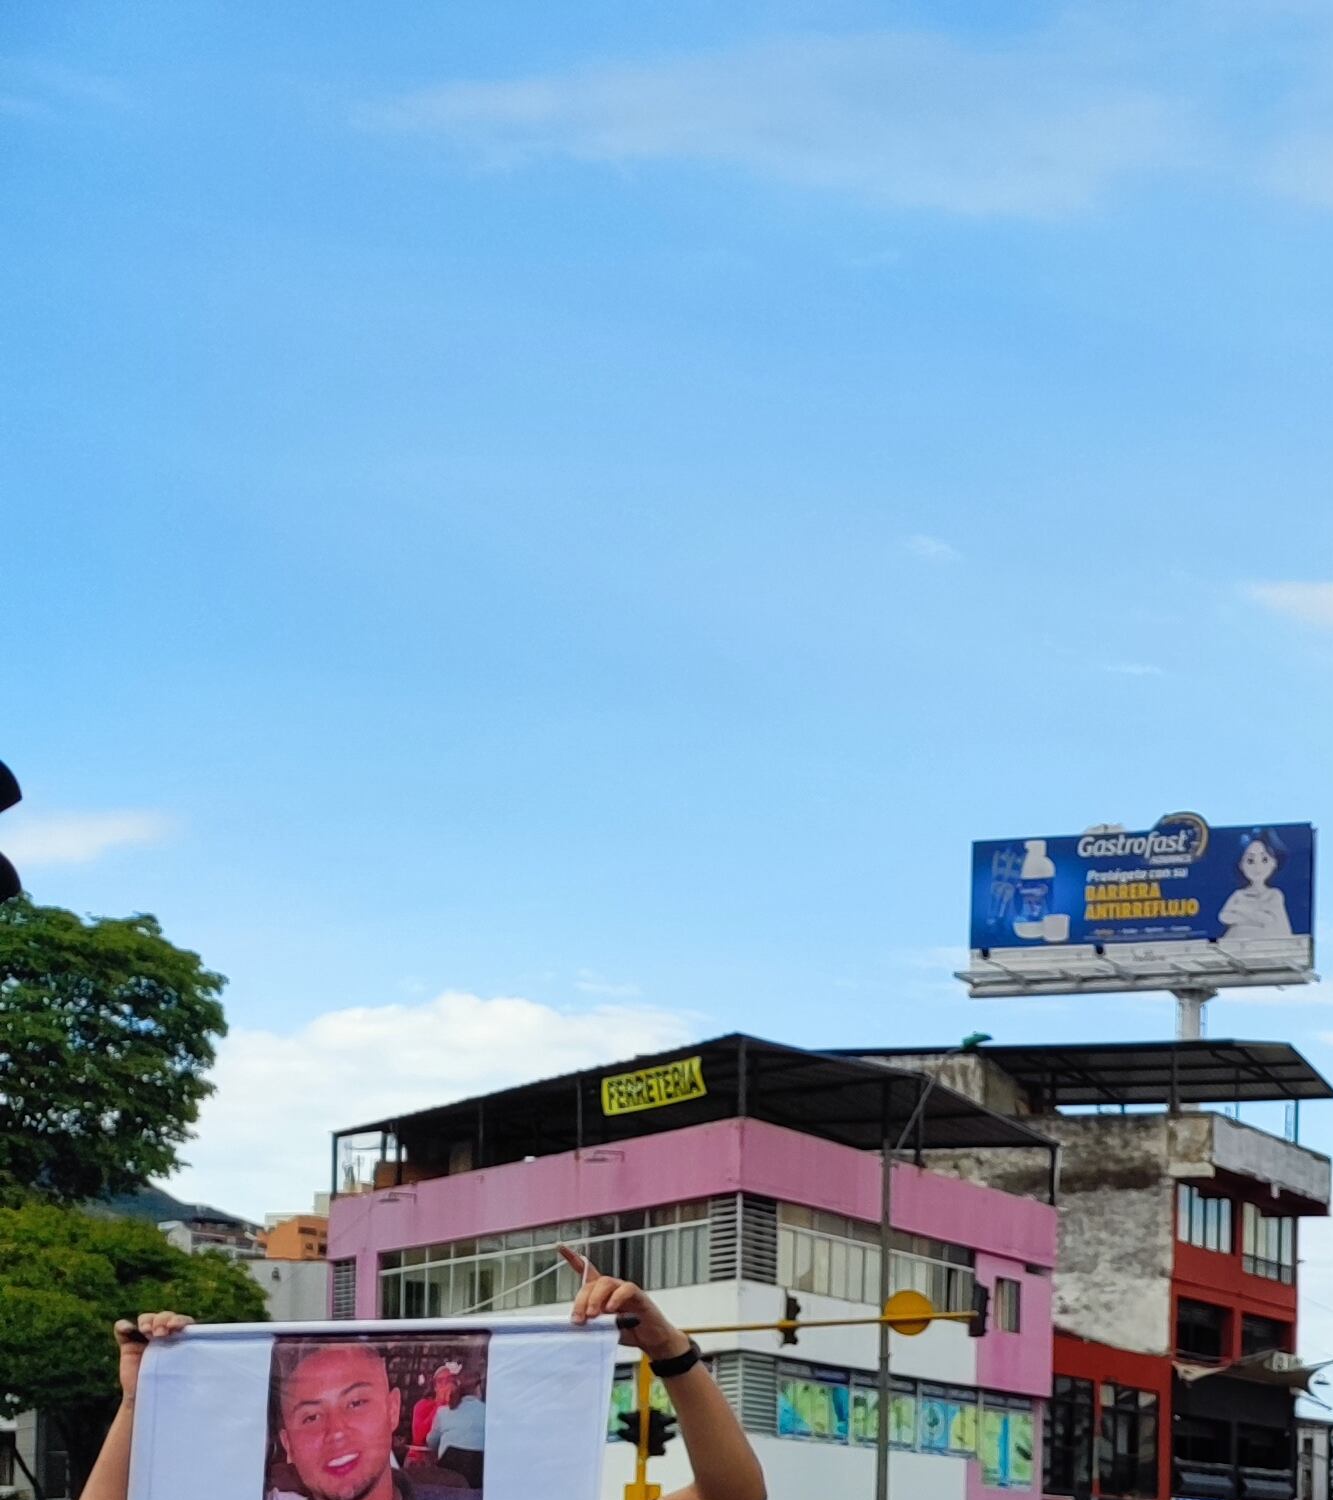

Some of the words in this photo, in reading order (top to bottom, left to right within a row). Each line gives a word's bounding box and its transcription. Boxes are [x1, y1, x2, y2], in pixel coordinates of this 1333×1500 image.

[1078, 829, 1187, 858] Gastrofast
[1085, 883, 1161, 901] BARRERA
[1085, 898, 1199, 920] ANTIRREFLUJO
